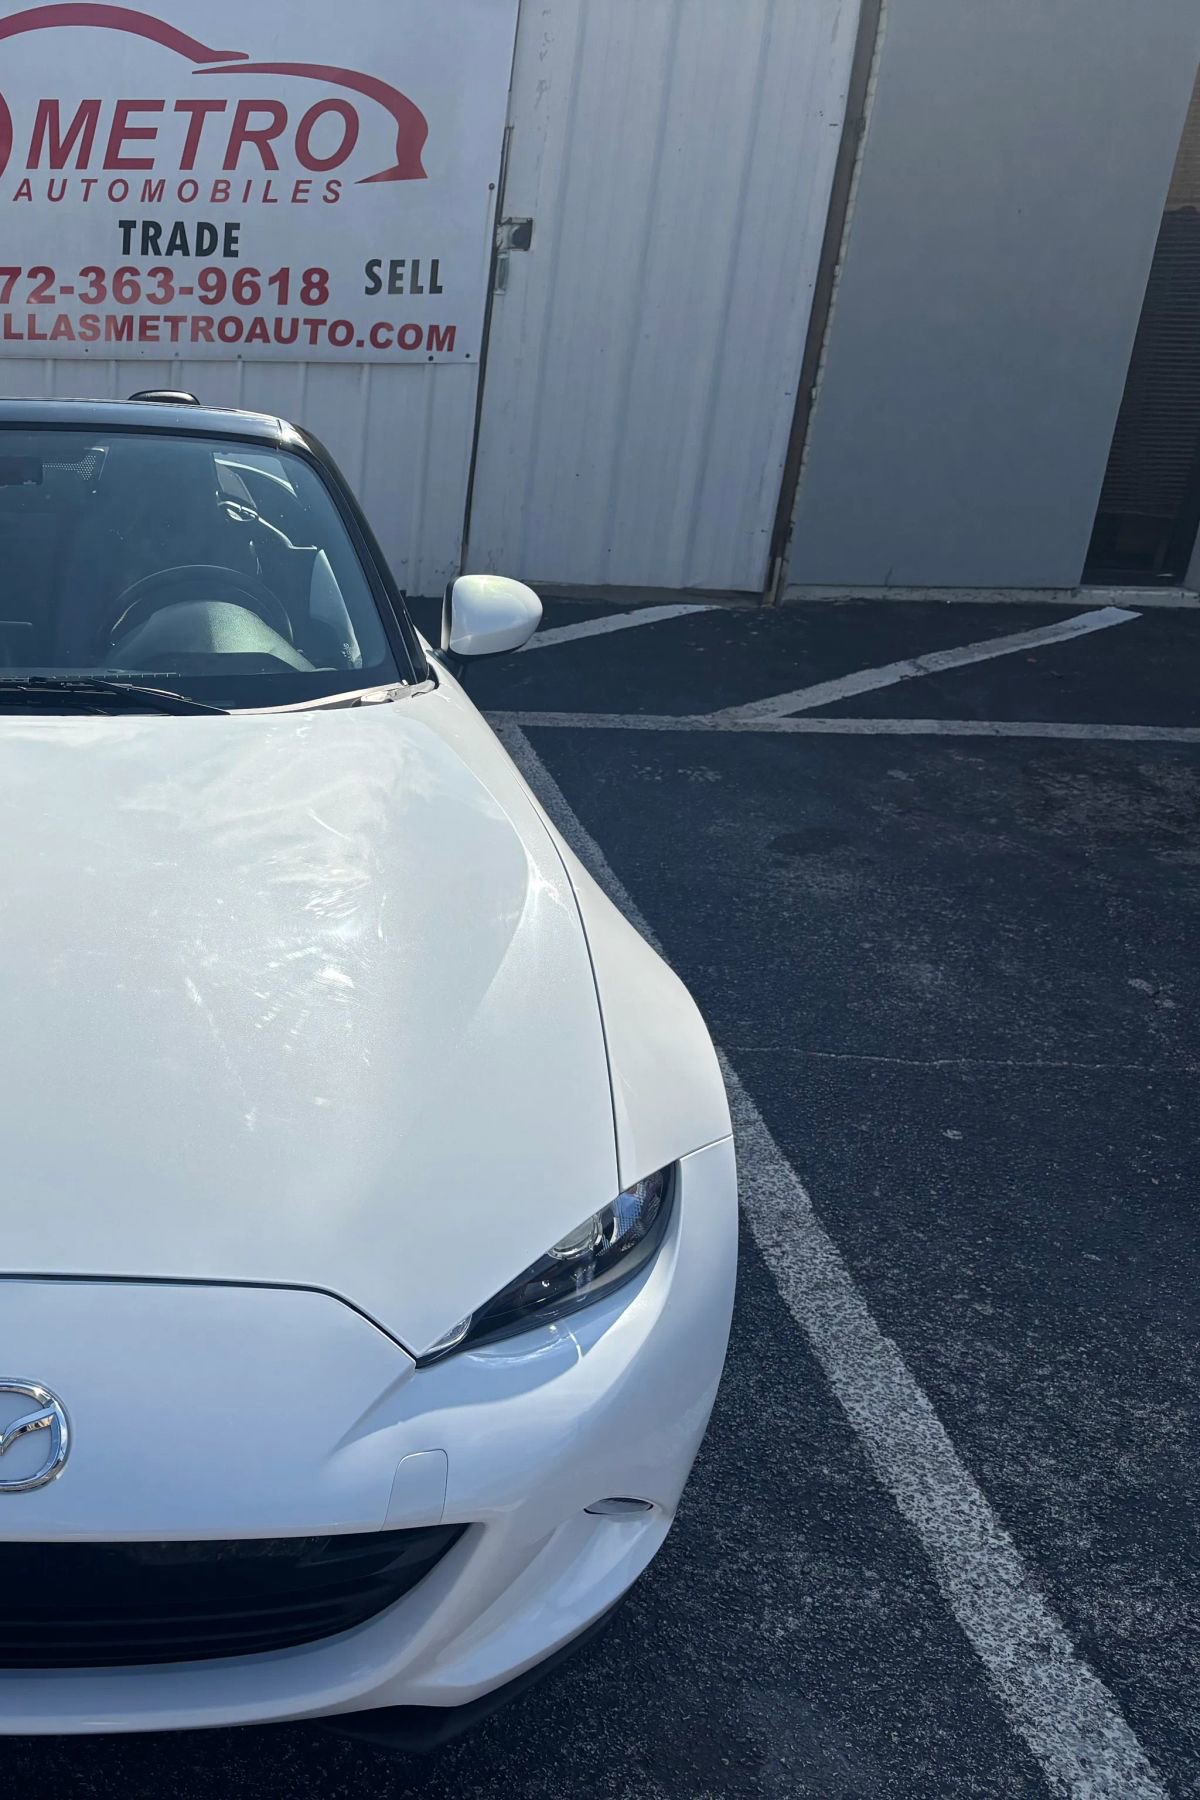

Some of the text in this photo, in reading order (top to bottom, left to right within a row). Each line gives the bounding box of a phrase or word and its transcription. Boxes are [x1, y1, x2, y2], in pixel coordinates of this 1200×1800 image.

[26, 98, 359, 172] METRO
[12, 178, 342, 205] AUTOMOBILES
[118, 219, 241, 258] TRADE
[364, 258, 443, 296] SELL
